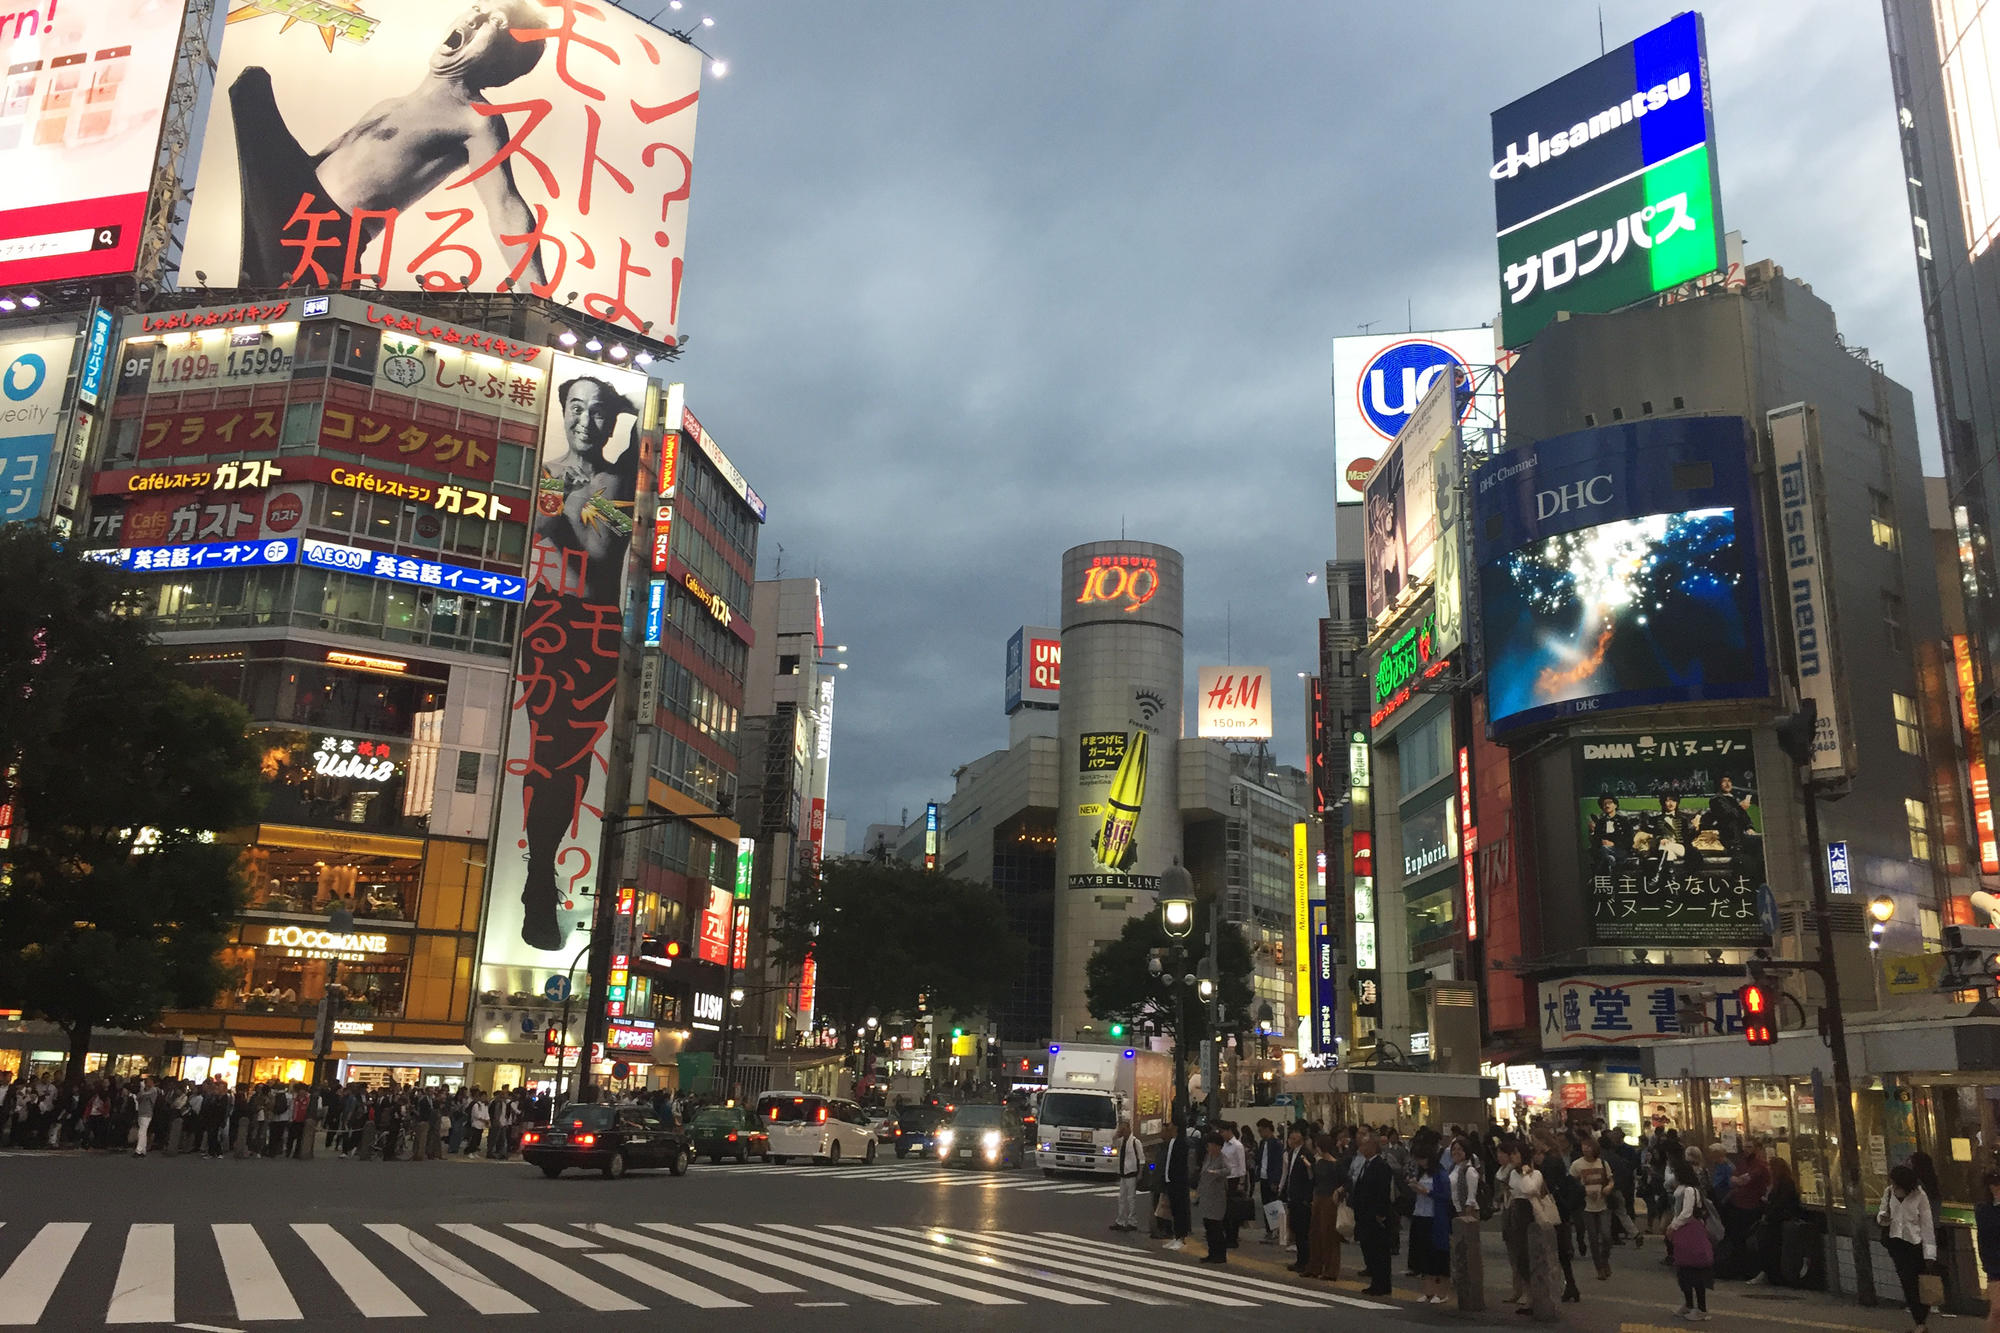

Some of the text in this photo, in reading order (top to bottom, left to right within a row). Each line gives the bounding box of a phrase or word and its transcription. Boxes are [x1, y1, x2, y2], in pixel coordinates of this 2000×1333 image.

[1489, 72, 1691, 180] Hisamitsu
[1504, 192, 1696, 304] サロンパス
[141, 301, 291, 331] しゃぶしゃぶバイキング
[366, 305, 542, 362] しゃぶしゃぶバイキング
[85, 321, 107, 388] 東急リバブル
[124, 359, 151, 378] 9F
[157, 354, 219, 384] 1,199円
[227, 347, 293, 379] 1,599円
[436, 359, 537, 407] しゃぶ葉
[145, 411, 278, 448] プライス
[322, 409, 490, 468] コンタクト
[213, 461, 282, 490] ガスト
[1479, 454, 1538, 493] DHC Channel
[434, 485, 512, 522] ガスト
[1536, 474, 1614, 521] DHC
[93, 514, 124, 538] 7F
[168, 502, 254, 541] ガスト
[270, 509, 298, 522] ガスト
[133, 545, 259, 570] 英会話イーオン
[267, 545, 285, 558] 6F
[655, 534, 667, 565] ガスト
[1092, 557, 1157, 568] SHIBUYA
[1780, 451, 1821, 678] Taisei neon
[308, 545, 522, 596] AEON 英会話イーオン
[1077, 565, 1159, 612] 109
[1208, 674, 1262, 710] H&M
[1576, 699, 1599, 712] DHC
[817, 680, 832, 760] BIC CAMERA
[1081, 735, 1124, 745] #まつげに
[1088, 746, 1125, 757] ガールズ
[1584, 739, 1746, 759] DMM バヌーシー
[313, 751, 395, 782] Ushi8
[1088, 758, 1116, 769] パワー
[1080, 805, 1099, 814] NEW
[1104, 821, 1132, 845] BIG
[1405, 841, 1448, 875] Euphoria
[1069, 875, 1161, 888] MAYBELLINE
[1593, 874, 1752, 895] 馬主じゃないよ
[1594, 898, 1754, 918] バヌーシーだよ
[1321, 943, 1331, 980] MIZUHO
[693, 992, 723, 1021] LUSH
